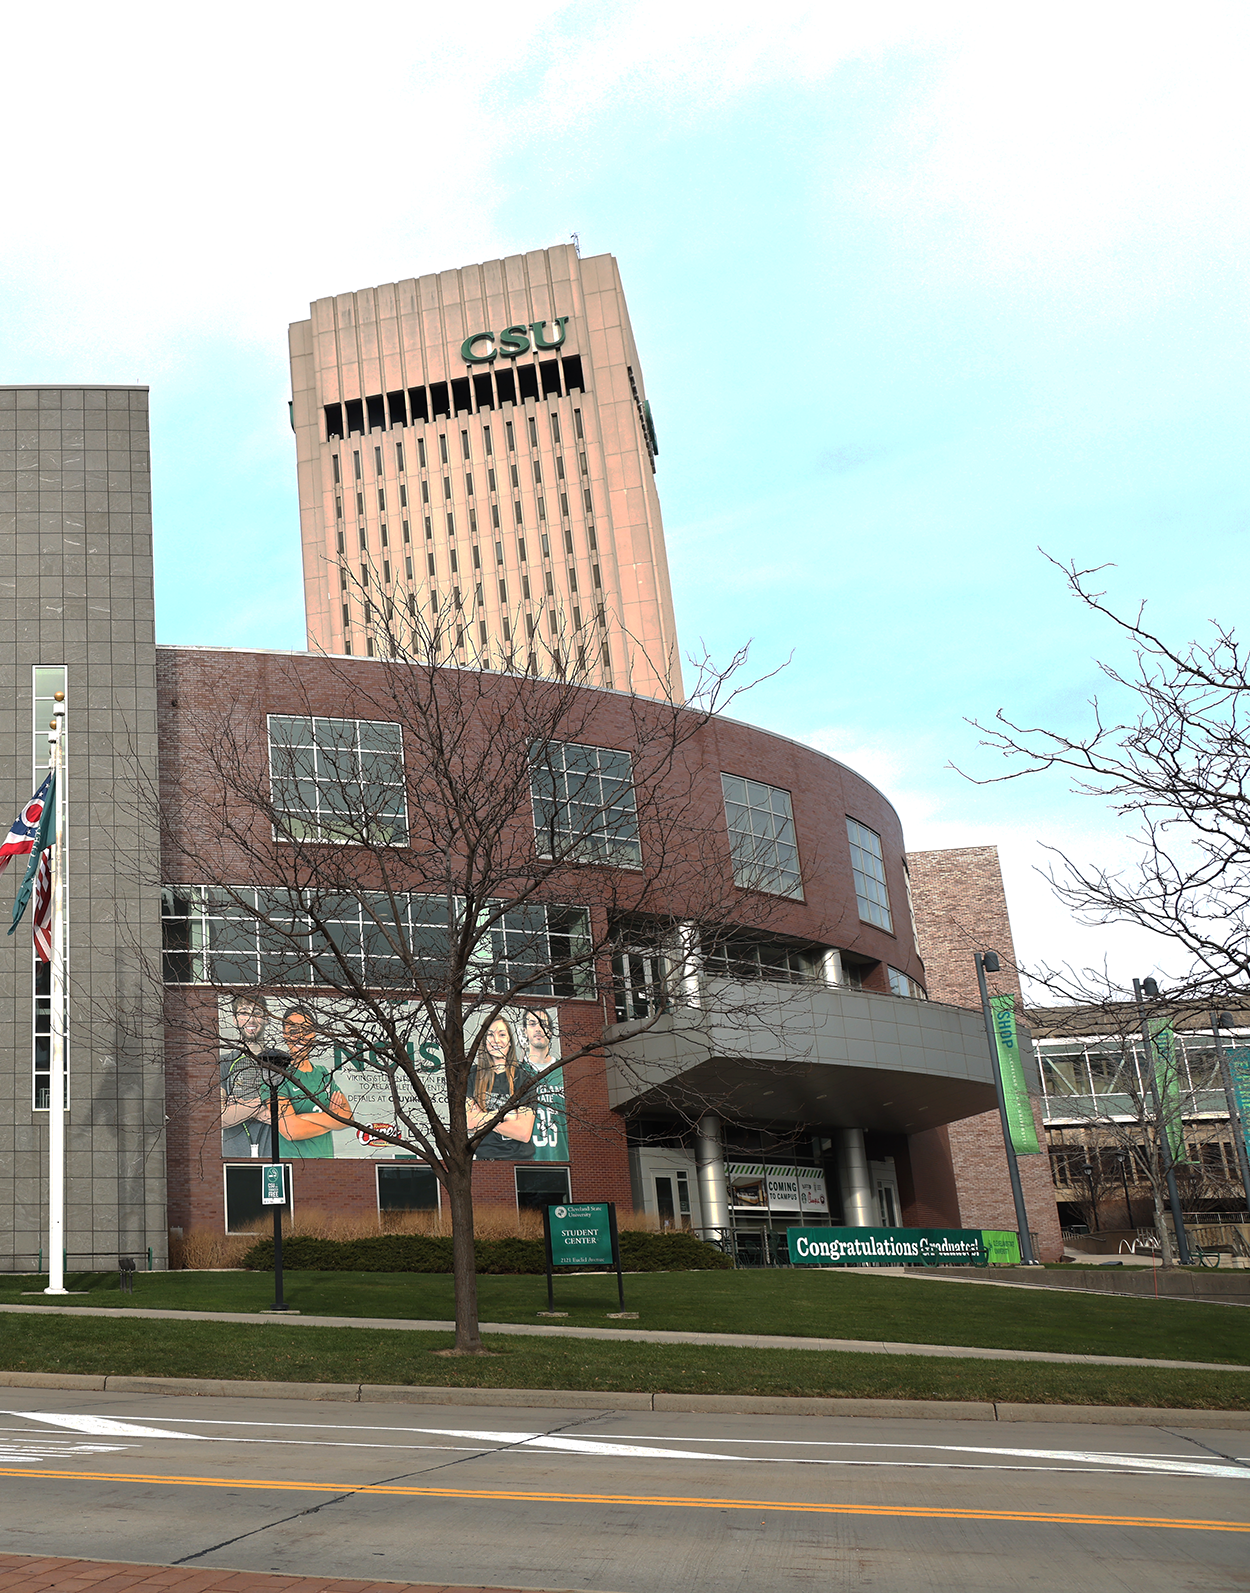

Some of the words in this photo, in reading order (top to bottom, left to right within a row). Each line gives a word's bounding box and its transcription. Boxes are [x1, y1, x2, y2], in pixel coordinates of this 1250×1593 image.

[460, 316, 569, 364] CSU
[997, 1011, 1013, 1048] SHOP
[768, 1181, 797, 1192] COMING
[769, 1192, 776, 1200] TO
[561, 1228, 599, 1237] STUDENT
[564, 1237, 597, 1245] CENTER
[796, 1236, 919, 1260] Congratulations
[919, 1237, 980, 1257] Graduates!
